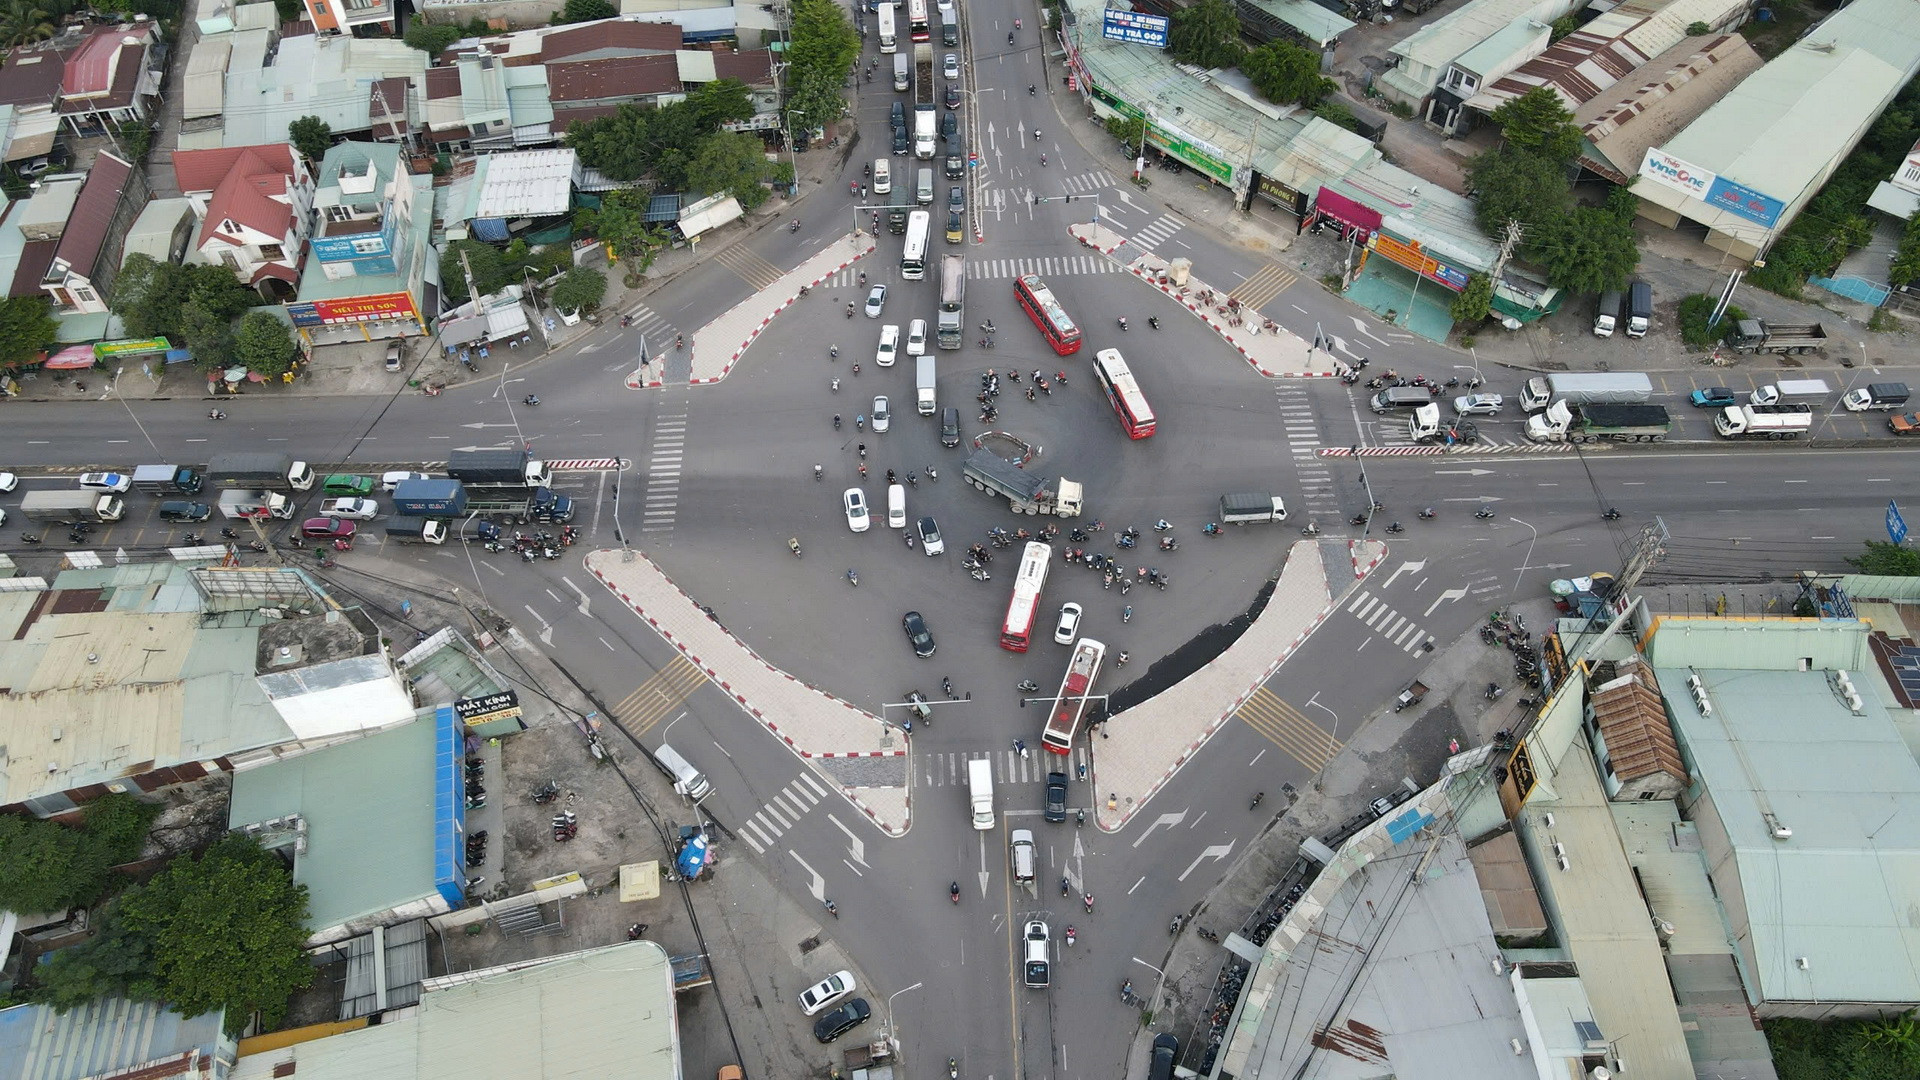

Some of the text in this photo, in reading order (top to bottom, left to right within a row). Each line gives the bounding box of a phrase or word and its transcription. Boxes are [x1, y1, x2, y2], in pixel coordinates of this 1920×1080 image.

[1106, 26, 1124, 35] BÁN
[1126, 29, 1142, 38] TRẢ
[1144, 31, 1163, 41] GÓP
[1664, 156, 1680, 168] Thép
[332, 306, 355, 314] SIÊU
[377, 302, 398, 311] SƠN
[456, 695, 511, 711] MẮT KÍNH
